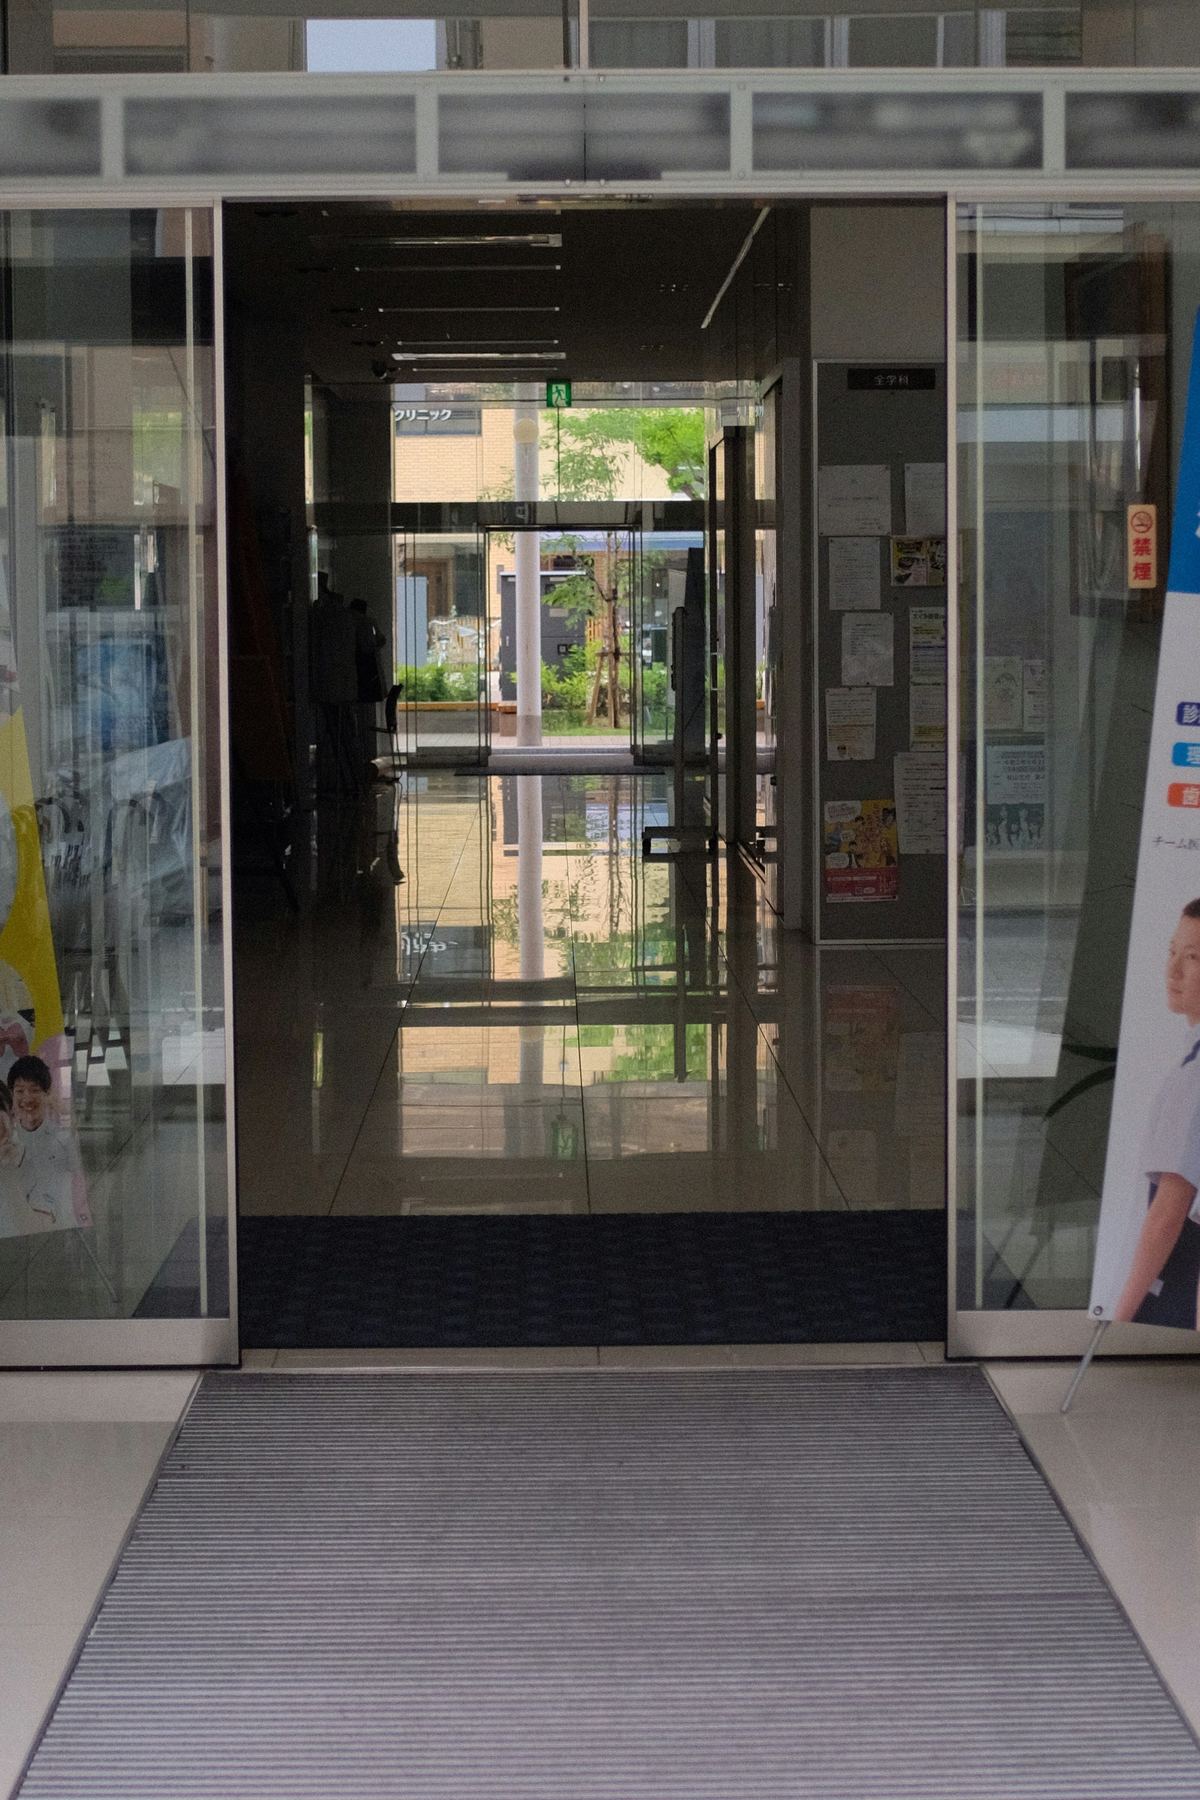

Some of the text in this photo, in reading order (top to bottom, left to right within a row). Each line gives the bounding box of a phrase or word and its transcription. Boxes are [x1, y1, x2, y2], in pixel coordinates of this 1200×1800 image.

[873, 374, 910, 387] 全学科
[394, 409, 452, 421] クリニック
[1132, 537, 1153, 581] 禁煙
[1183, 704, 1200, 723] 診
